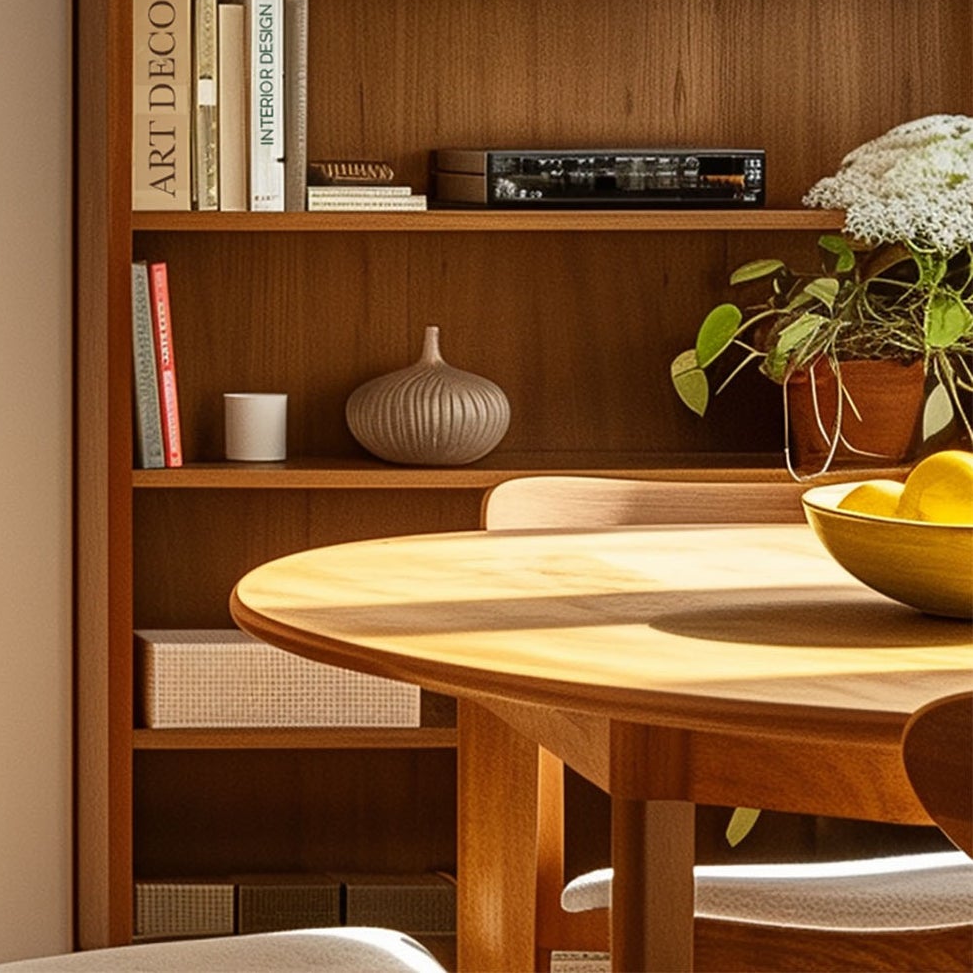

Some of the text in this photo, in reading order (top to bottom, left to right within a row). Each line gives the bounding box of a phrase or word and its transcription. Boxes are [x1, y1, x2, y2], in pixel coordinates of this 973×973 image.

[147, 0, 176, 198] ART DECO
[258, 3, 274, 146] INTERIOR DESIGN
